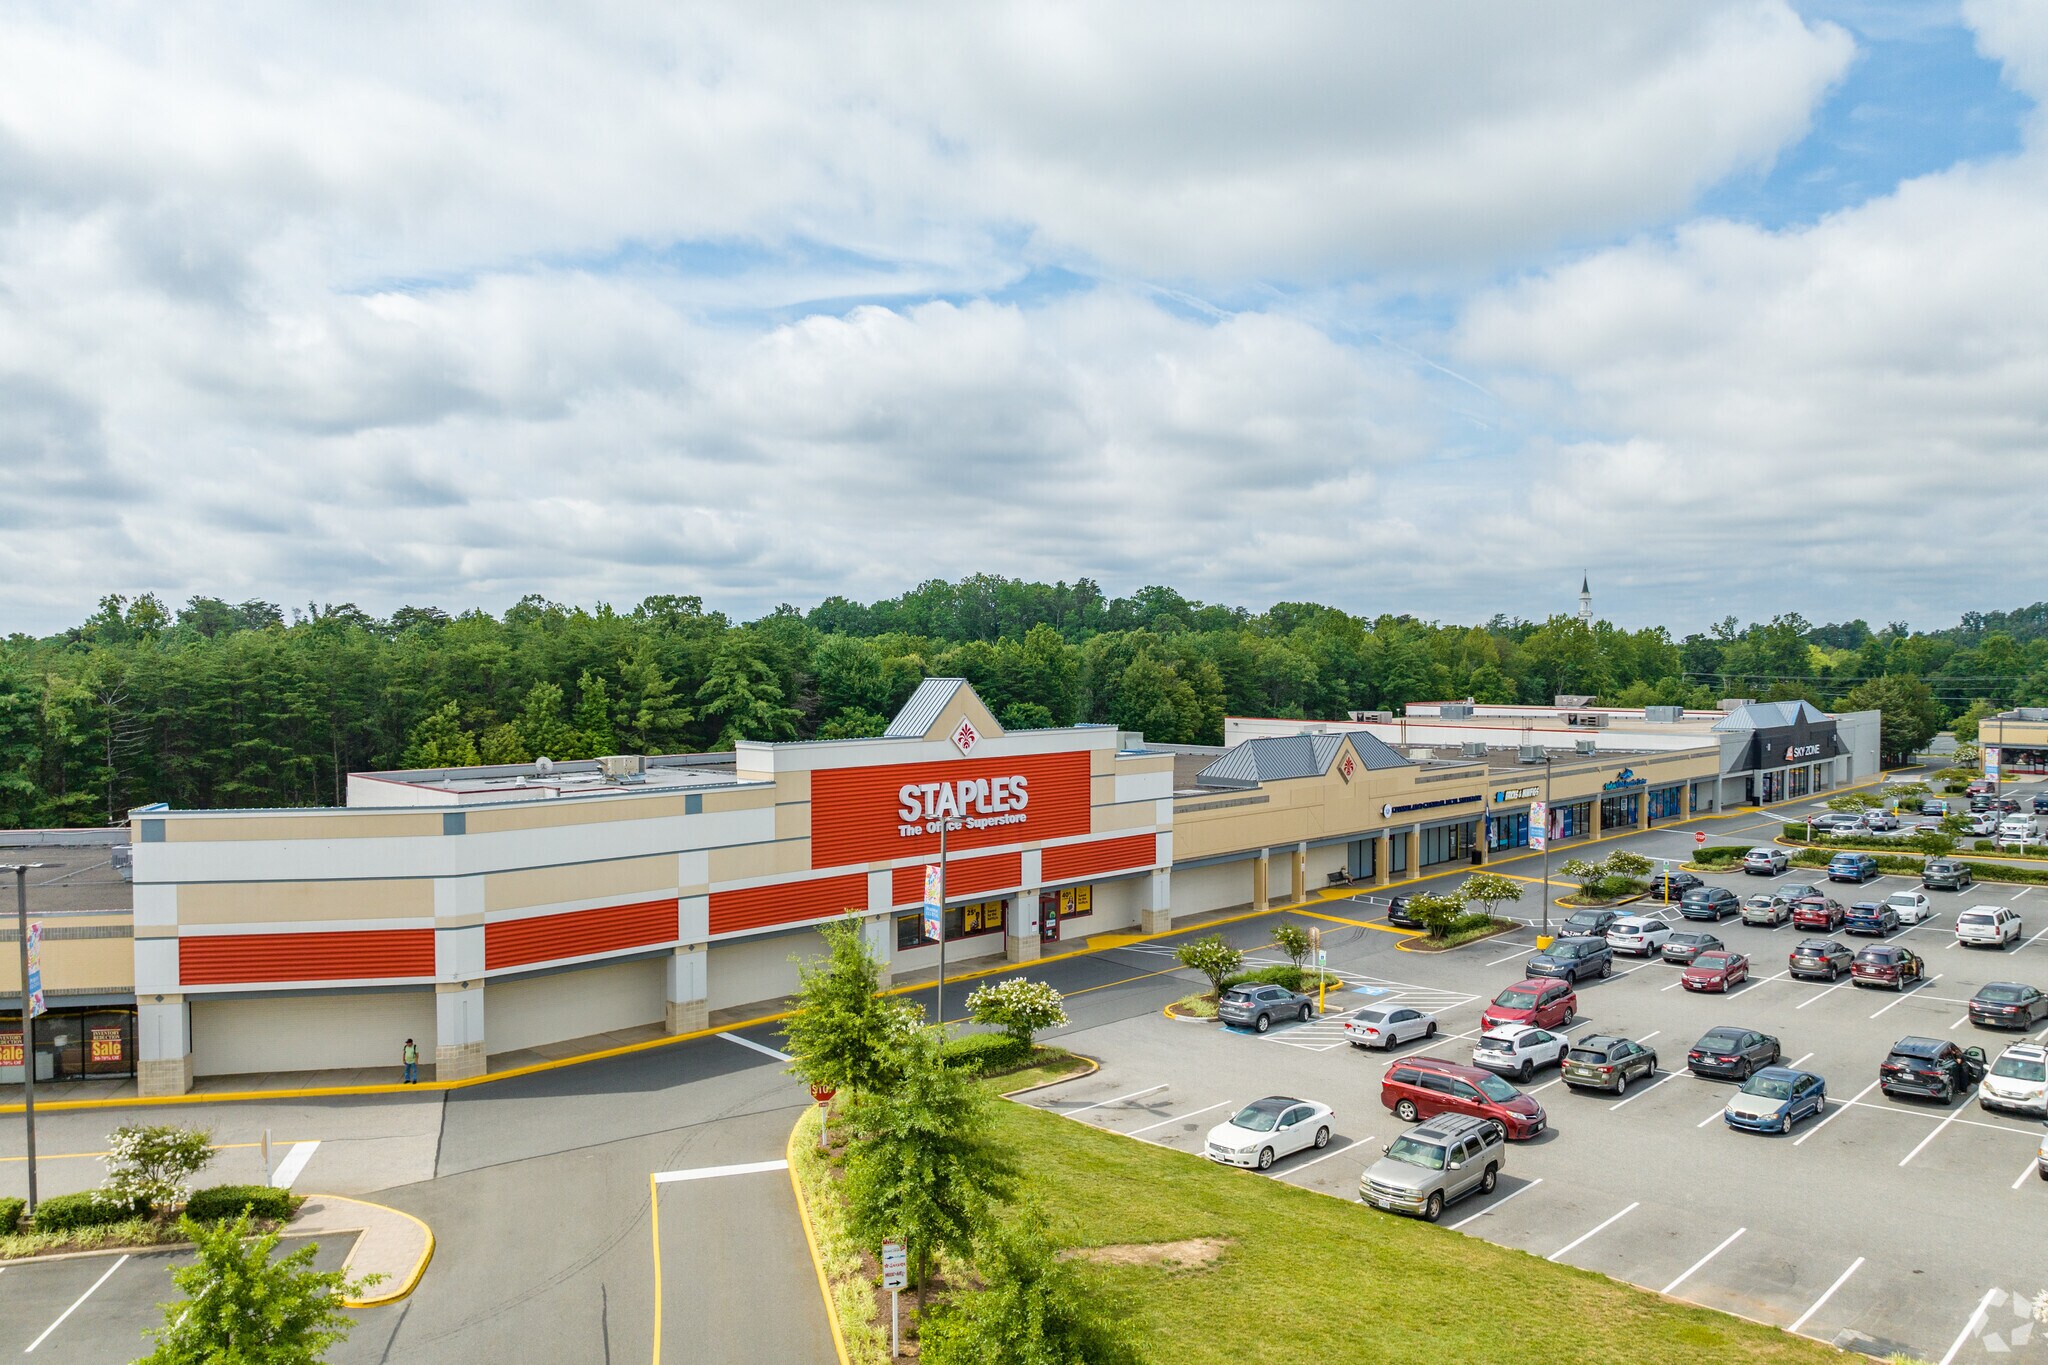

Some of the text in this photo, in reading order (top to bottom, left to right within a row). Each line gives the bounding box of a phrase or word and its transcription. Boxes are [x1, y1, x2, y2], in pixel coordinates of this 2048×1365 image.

[1793, 744, 1821, 758] SKY ZONE
[898, 775, 1028, 822] STAPLES
[898, 813, 1027, 837] The Ofice Superstore
[92, 1041, 122, 1056] Sale
[811, 1084, 832, 1095] STO
